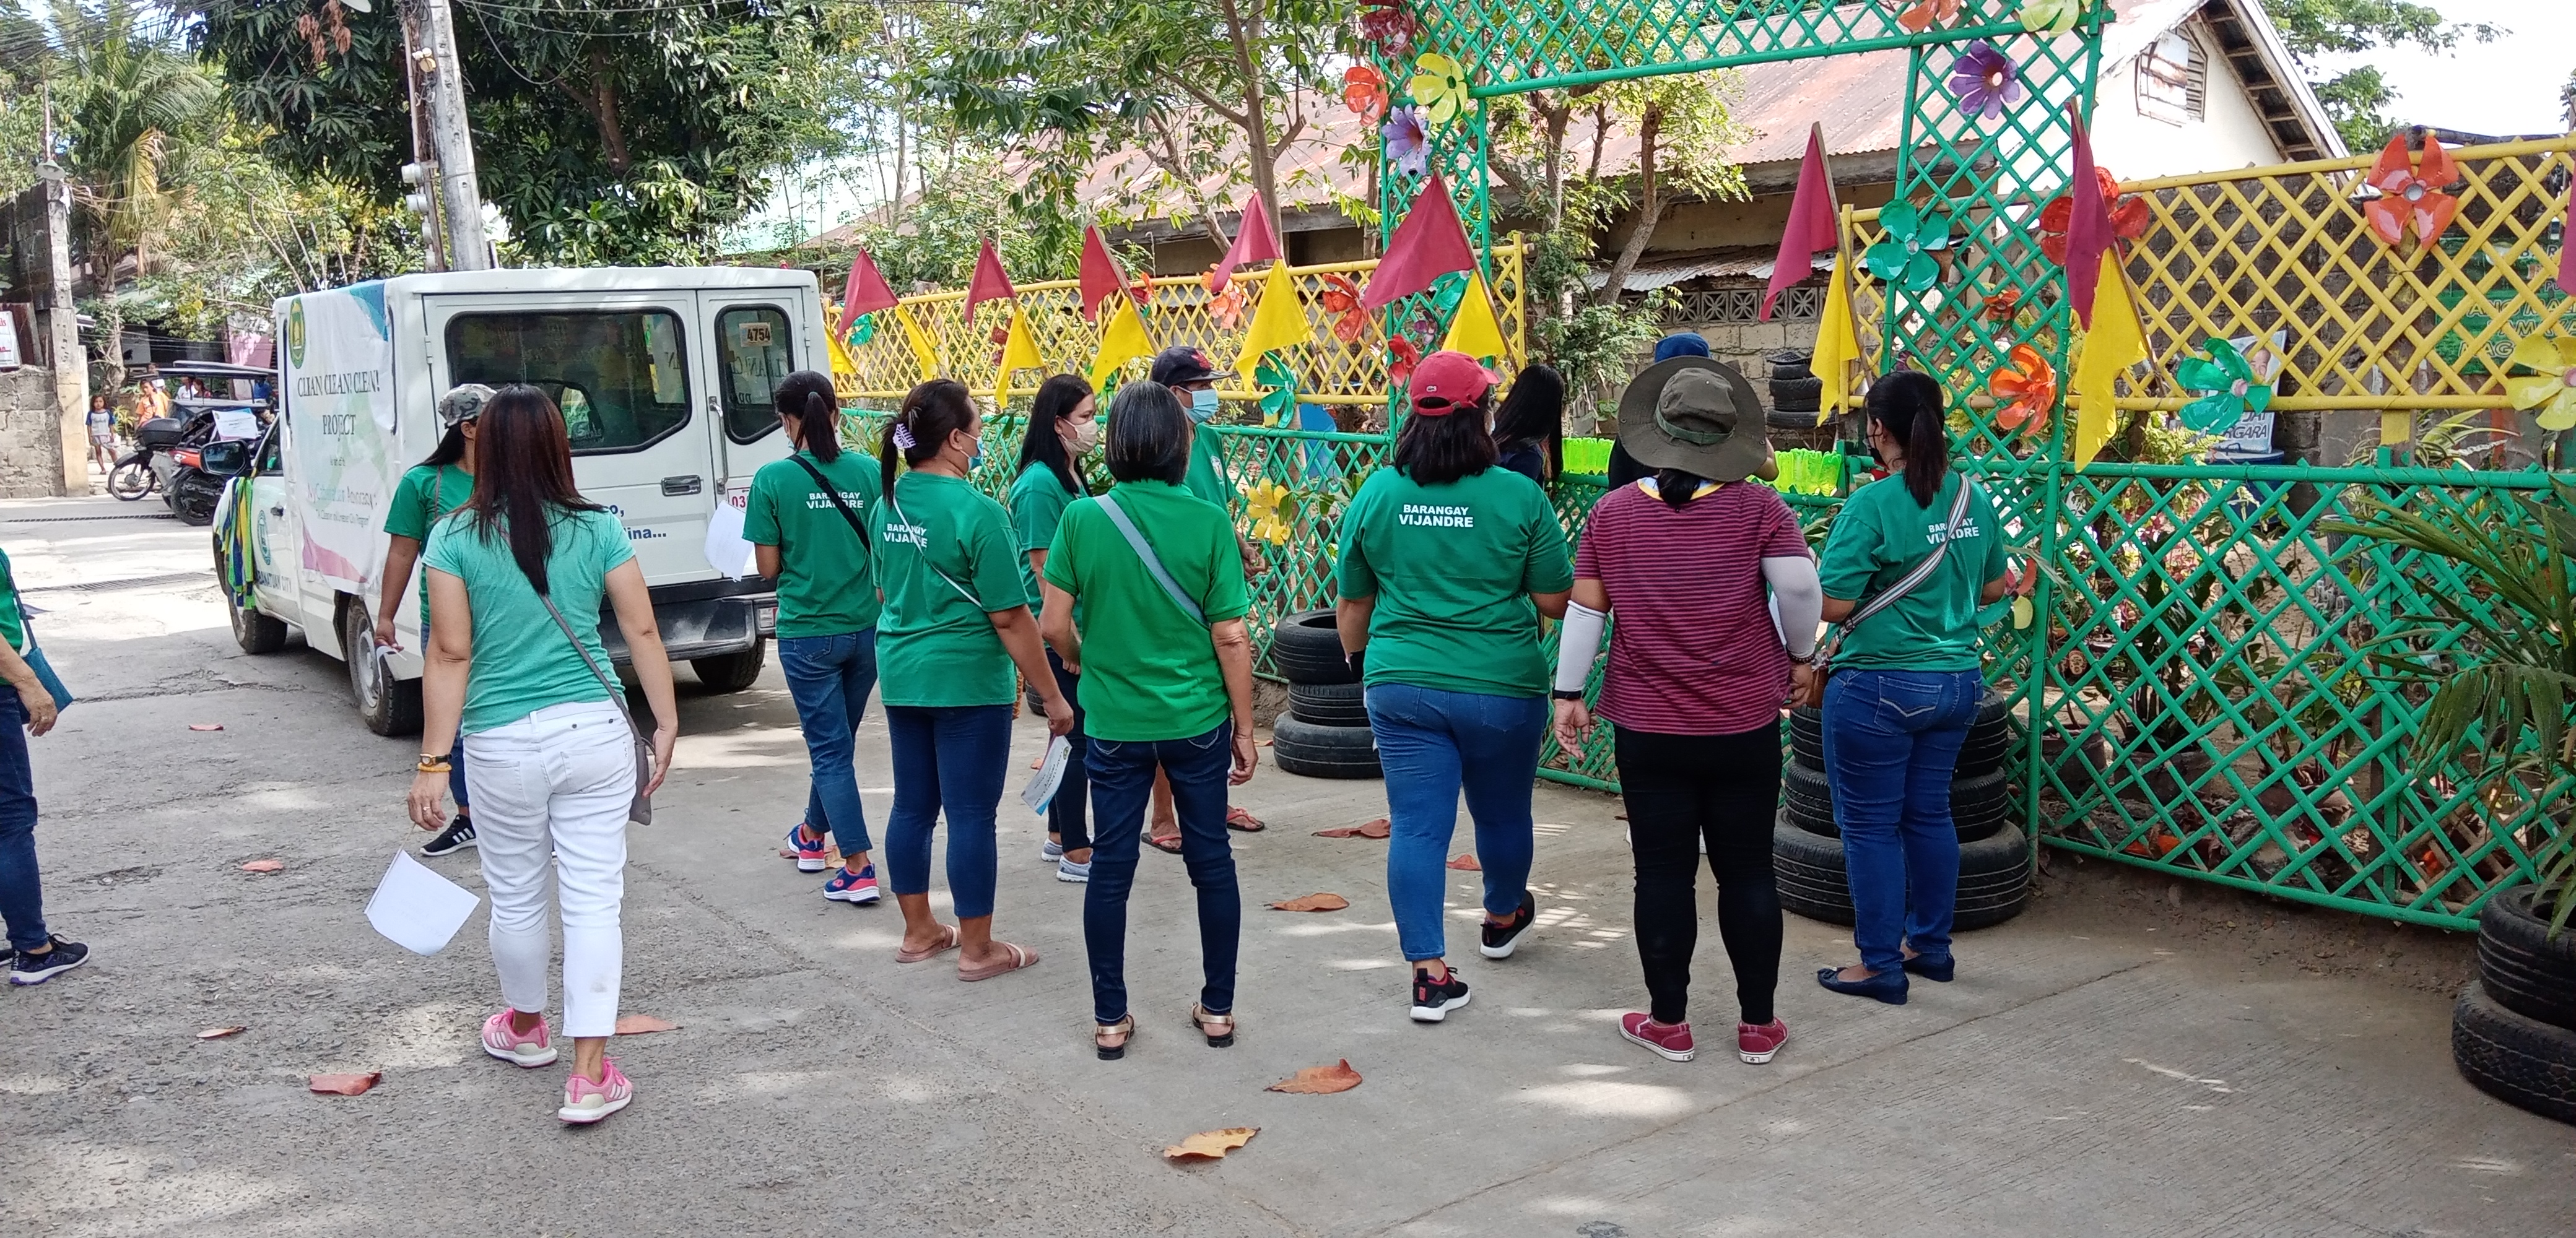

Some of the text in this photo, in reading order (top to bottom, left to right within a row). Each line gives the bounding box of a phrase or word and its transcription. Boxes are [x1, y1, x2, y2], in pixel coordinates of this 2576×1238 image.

[747, 328, 770, 341] 4754
[1403, 504, 1469, 516] BARANGAY
[1399, 514, 1473, 527] VIJANDRE
